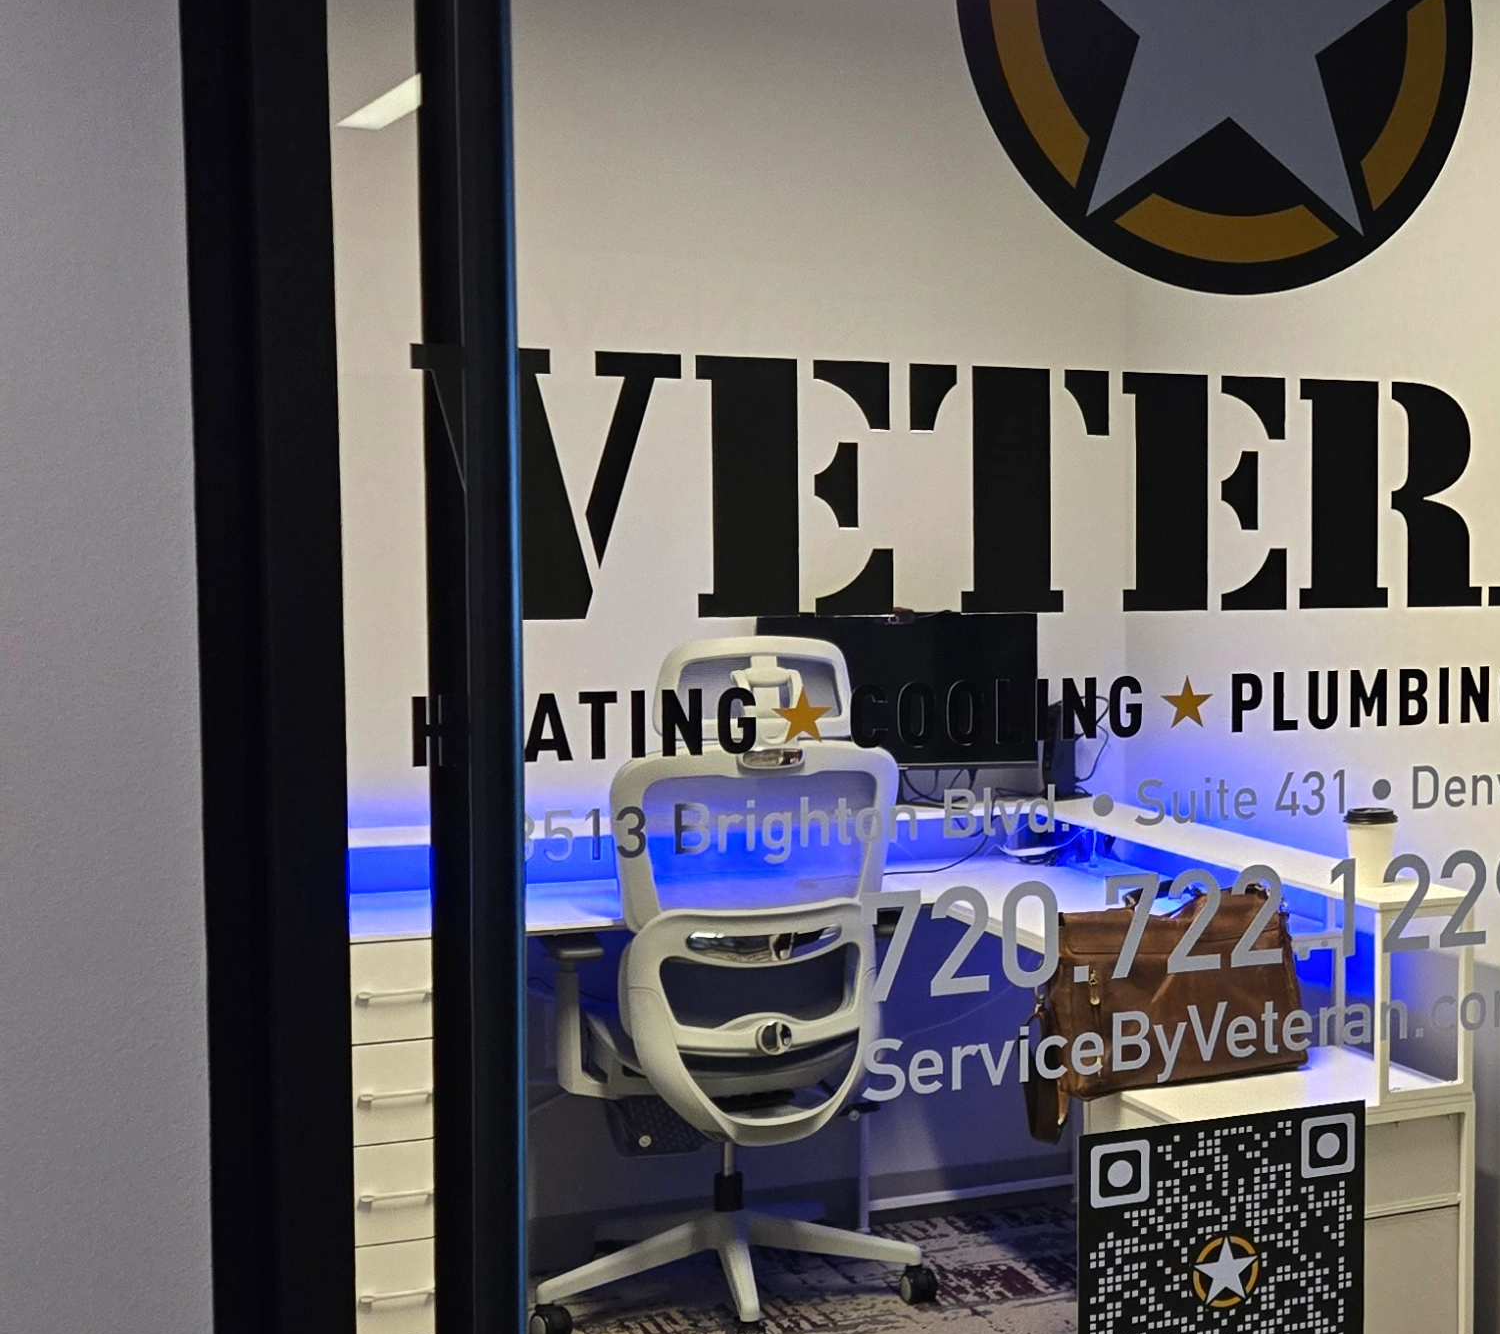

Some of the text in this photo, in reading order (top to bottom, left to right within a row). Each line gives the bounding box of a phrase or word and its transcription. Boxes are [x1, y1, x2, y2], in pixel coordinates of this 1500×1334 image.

[411, 686, 758, 767] HATING
[850, 675, 1143, 749] COOLING
[674, 796, 918, 864] Brighton
[942, 784, 1070, 839] Blvd.
[1134, 776, 1258, 827] Suite
[1274, 769, 1349, 817] 431
